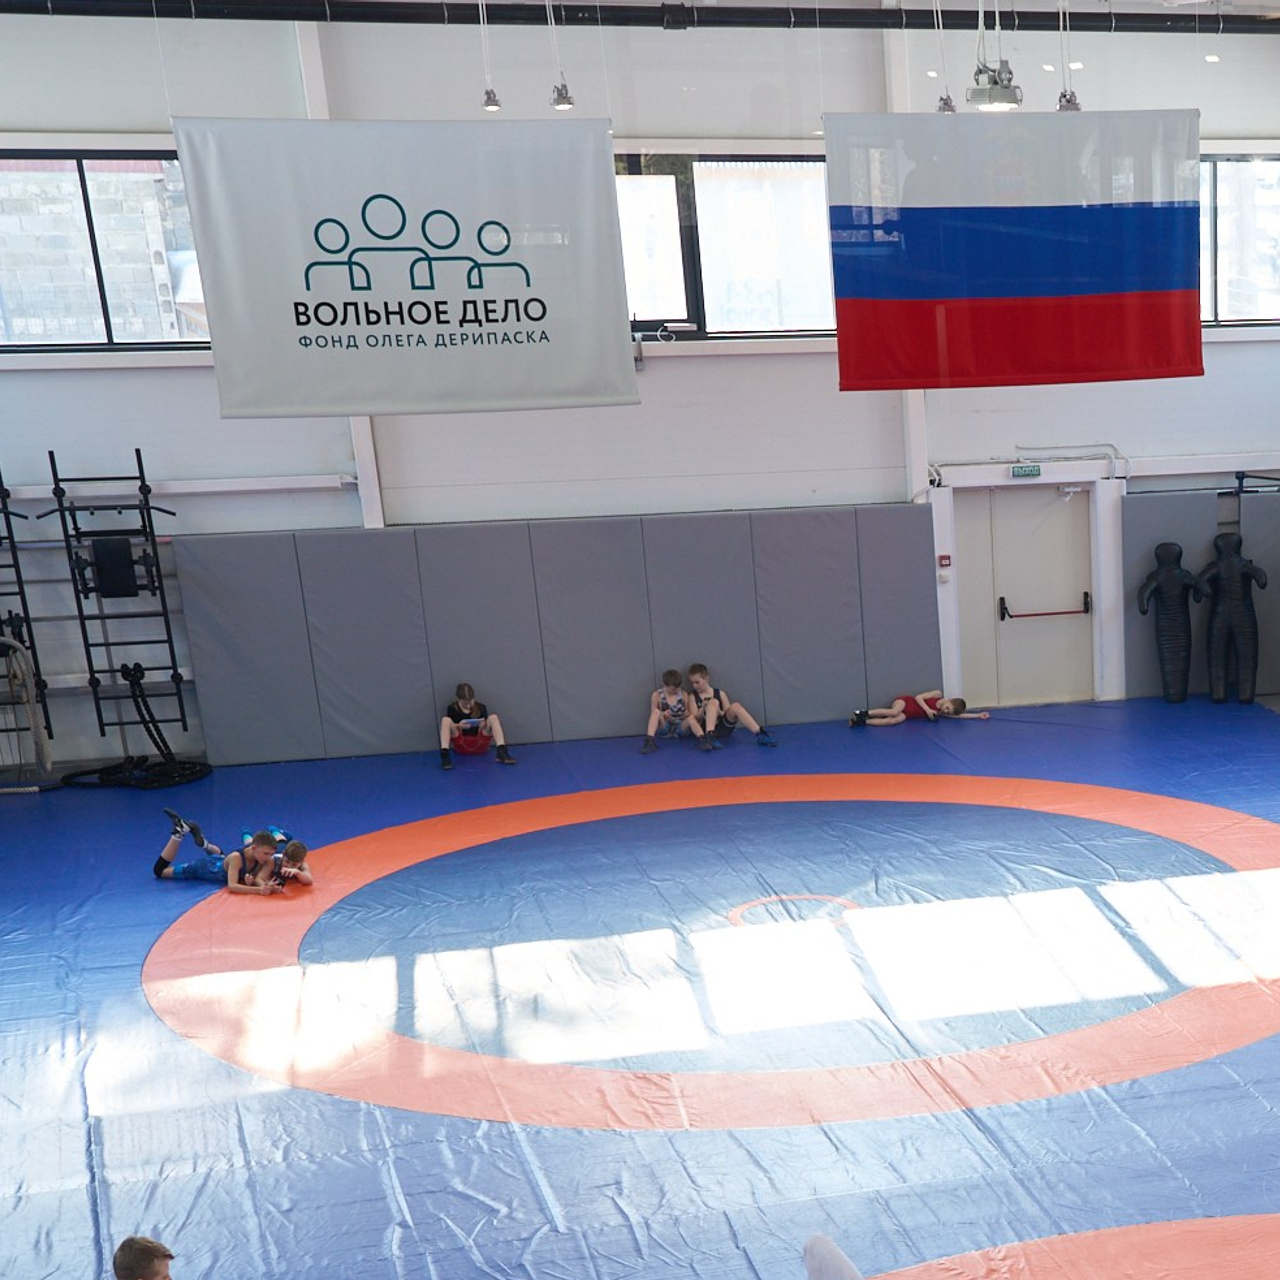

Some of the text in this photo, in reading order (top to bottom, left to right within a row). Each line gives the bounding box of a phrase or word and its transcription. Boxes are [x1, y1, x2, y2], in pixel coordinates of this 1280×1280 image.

[293, 298, 548, 328] ВОЛЬНОЕ ДЕЛО
[298, 330, 551, 350] ФОНД ОЛЕГА ДЕРИПАСКА
